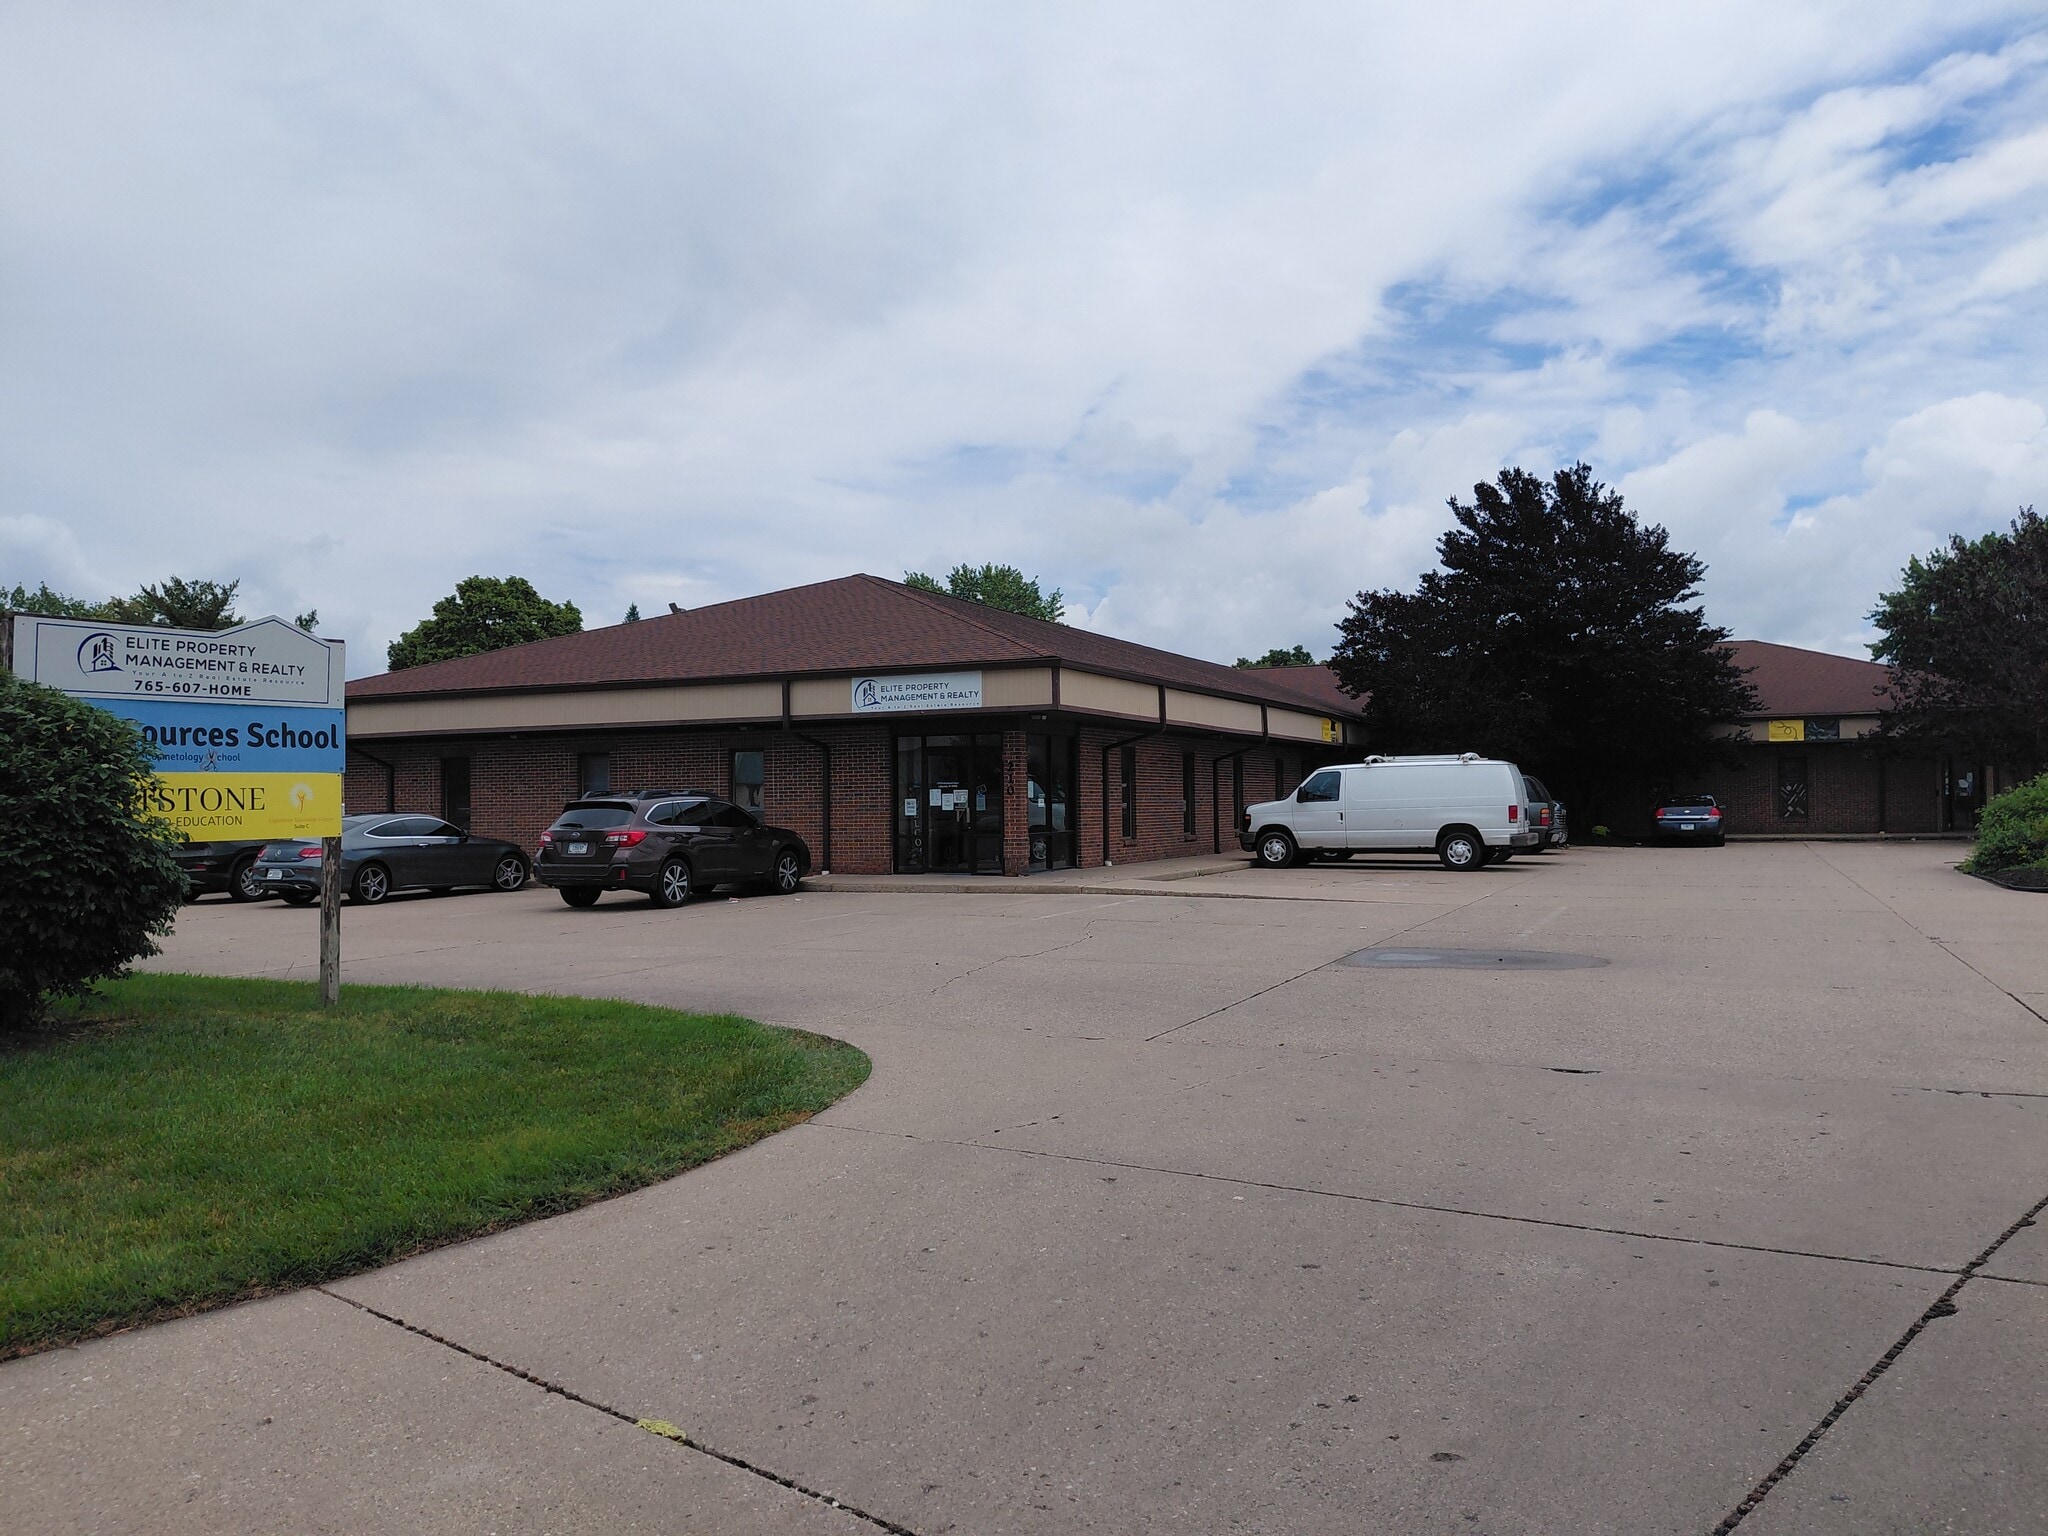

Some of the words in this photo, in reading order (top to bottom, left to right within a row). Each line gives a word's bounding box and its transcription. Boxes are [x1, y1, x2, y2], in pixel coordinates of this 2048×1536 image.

[126, 637, 170, 651] ELITE
[176, 641, 256, 657] PROPERTY
[126, 654, 236, 672] MANAGEMENT
[239, 662, 248, 673] &
[252, 663, 305, 676] REALTY
[134, 680, 252, 696] 765-607-HOME
[880, 684, 903, 693] ELITE
[905, 682, 950, 692] PROPERTY
[880, 692, 938, 702] MANAGEMENT
[947, 690, 980, 699] REALTY
[246, 722, 339, 749] School
